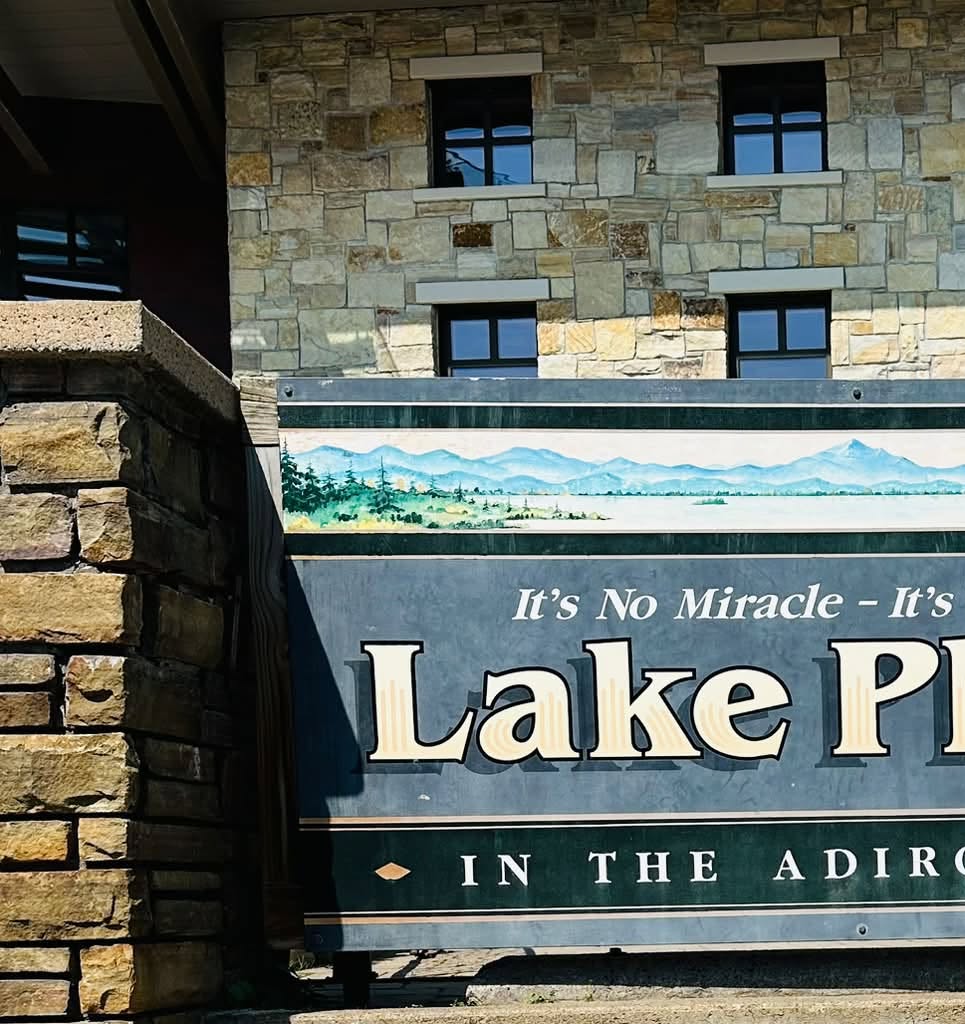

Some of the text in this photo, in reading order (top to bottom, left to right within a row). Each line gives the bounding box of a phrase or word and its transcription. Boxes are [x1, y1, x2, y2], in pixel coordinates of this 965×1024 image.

[511, 584, 580, 621] It's
[595, 588, 658, 621] No
[673, 582, 845, 620] Miracle
[887, 584, 955, 618] It's
[359, 634, 792, 766] Lake
[460, 853, 533, 887] IN
[588, 850, 719, 884] THE
